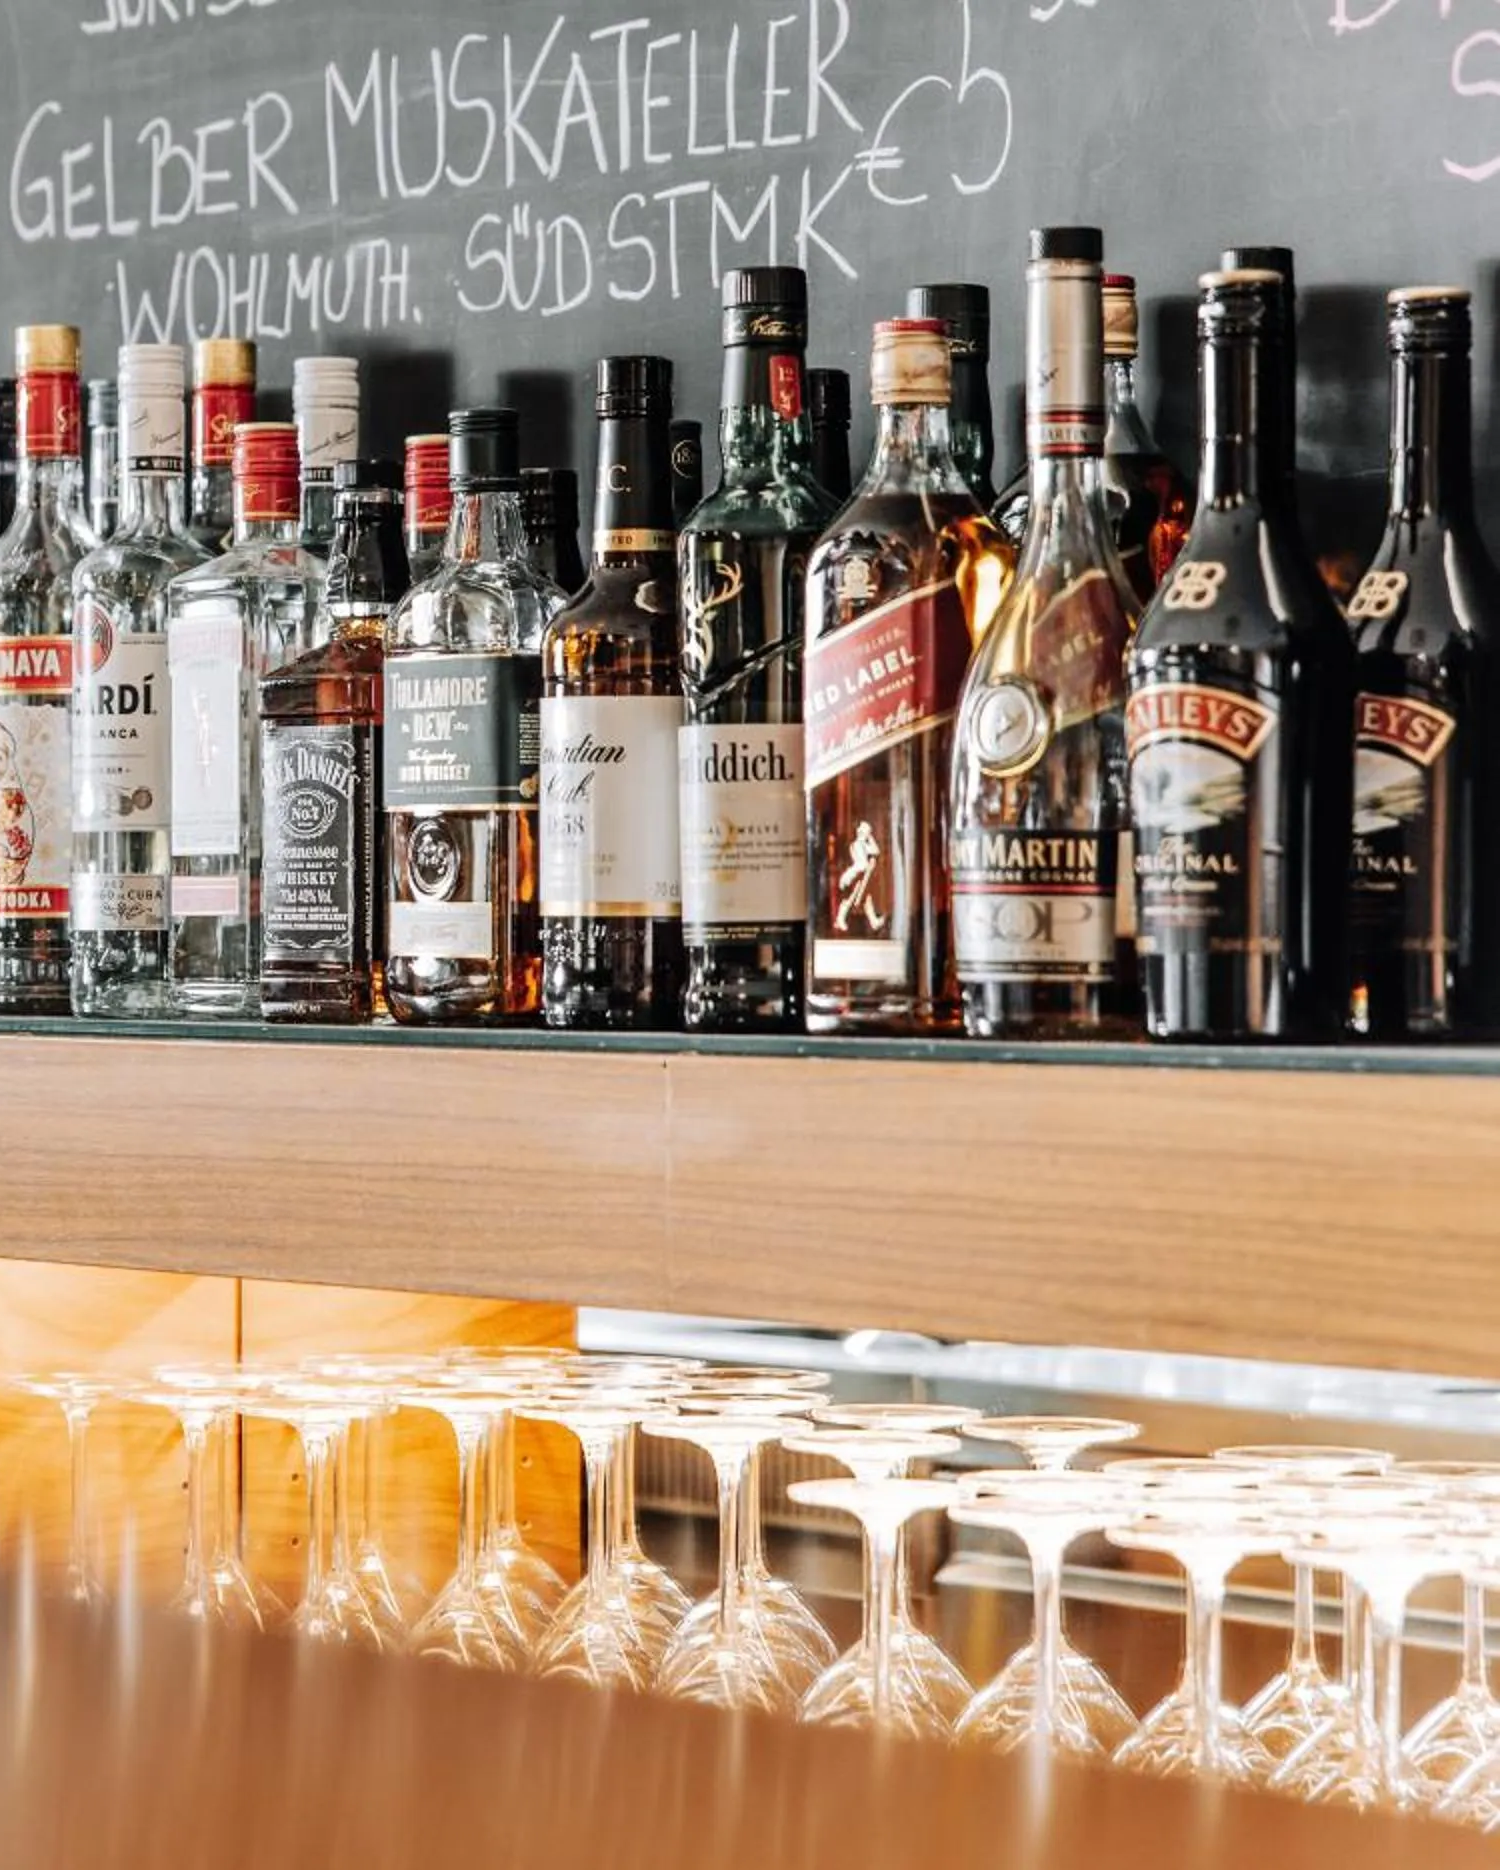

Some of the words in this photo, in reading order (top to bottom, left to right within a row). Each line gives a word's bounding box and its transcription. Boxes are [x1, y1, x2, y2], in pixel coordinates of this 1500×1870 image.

[8, 91, 300, 242] GELBER
[324, 0, 864, 206] MUSKATELLER
[844, 645, 917, 696] LABEL
[92, 672, 157, 716] RDÍ
[389, 671, 488, 711] TULLAMORE
[97, 727, 141, 739] ANCA
[981, 832, 1099, 869] MARTIN
[127, 889, 163, 902] CUBA
[275, 871, 339, 885] WHISKEY
